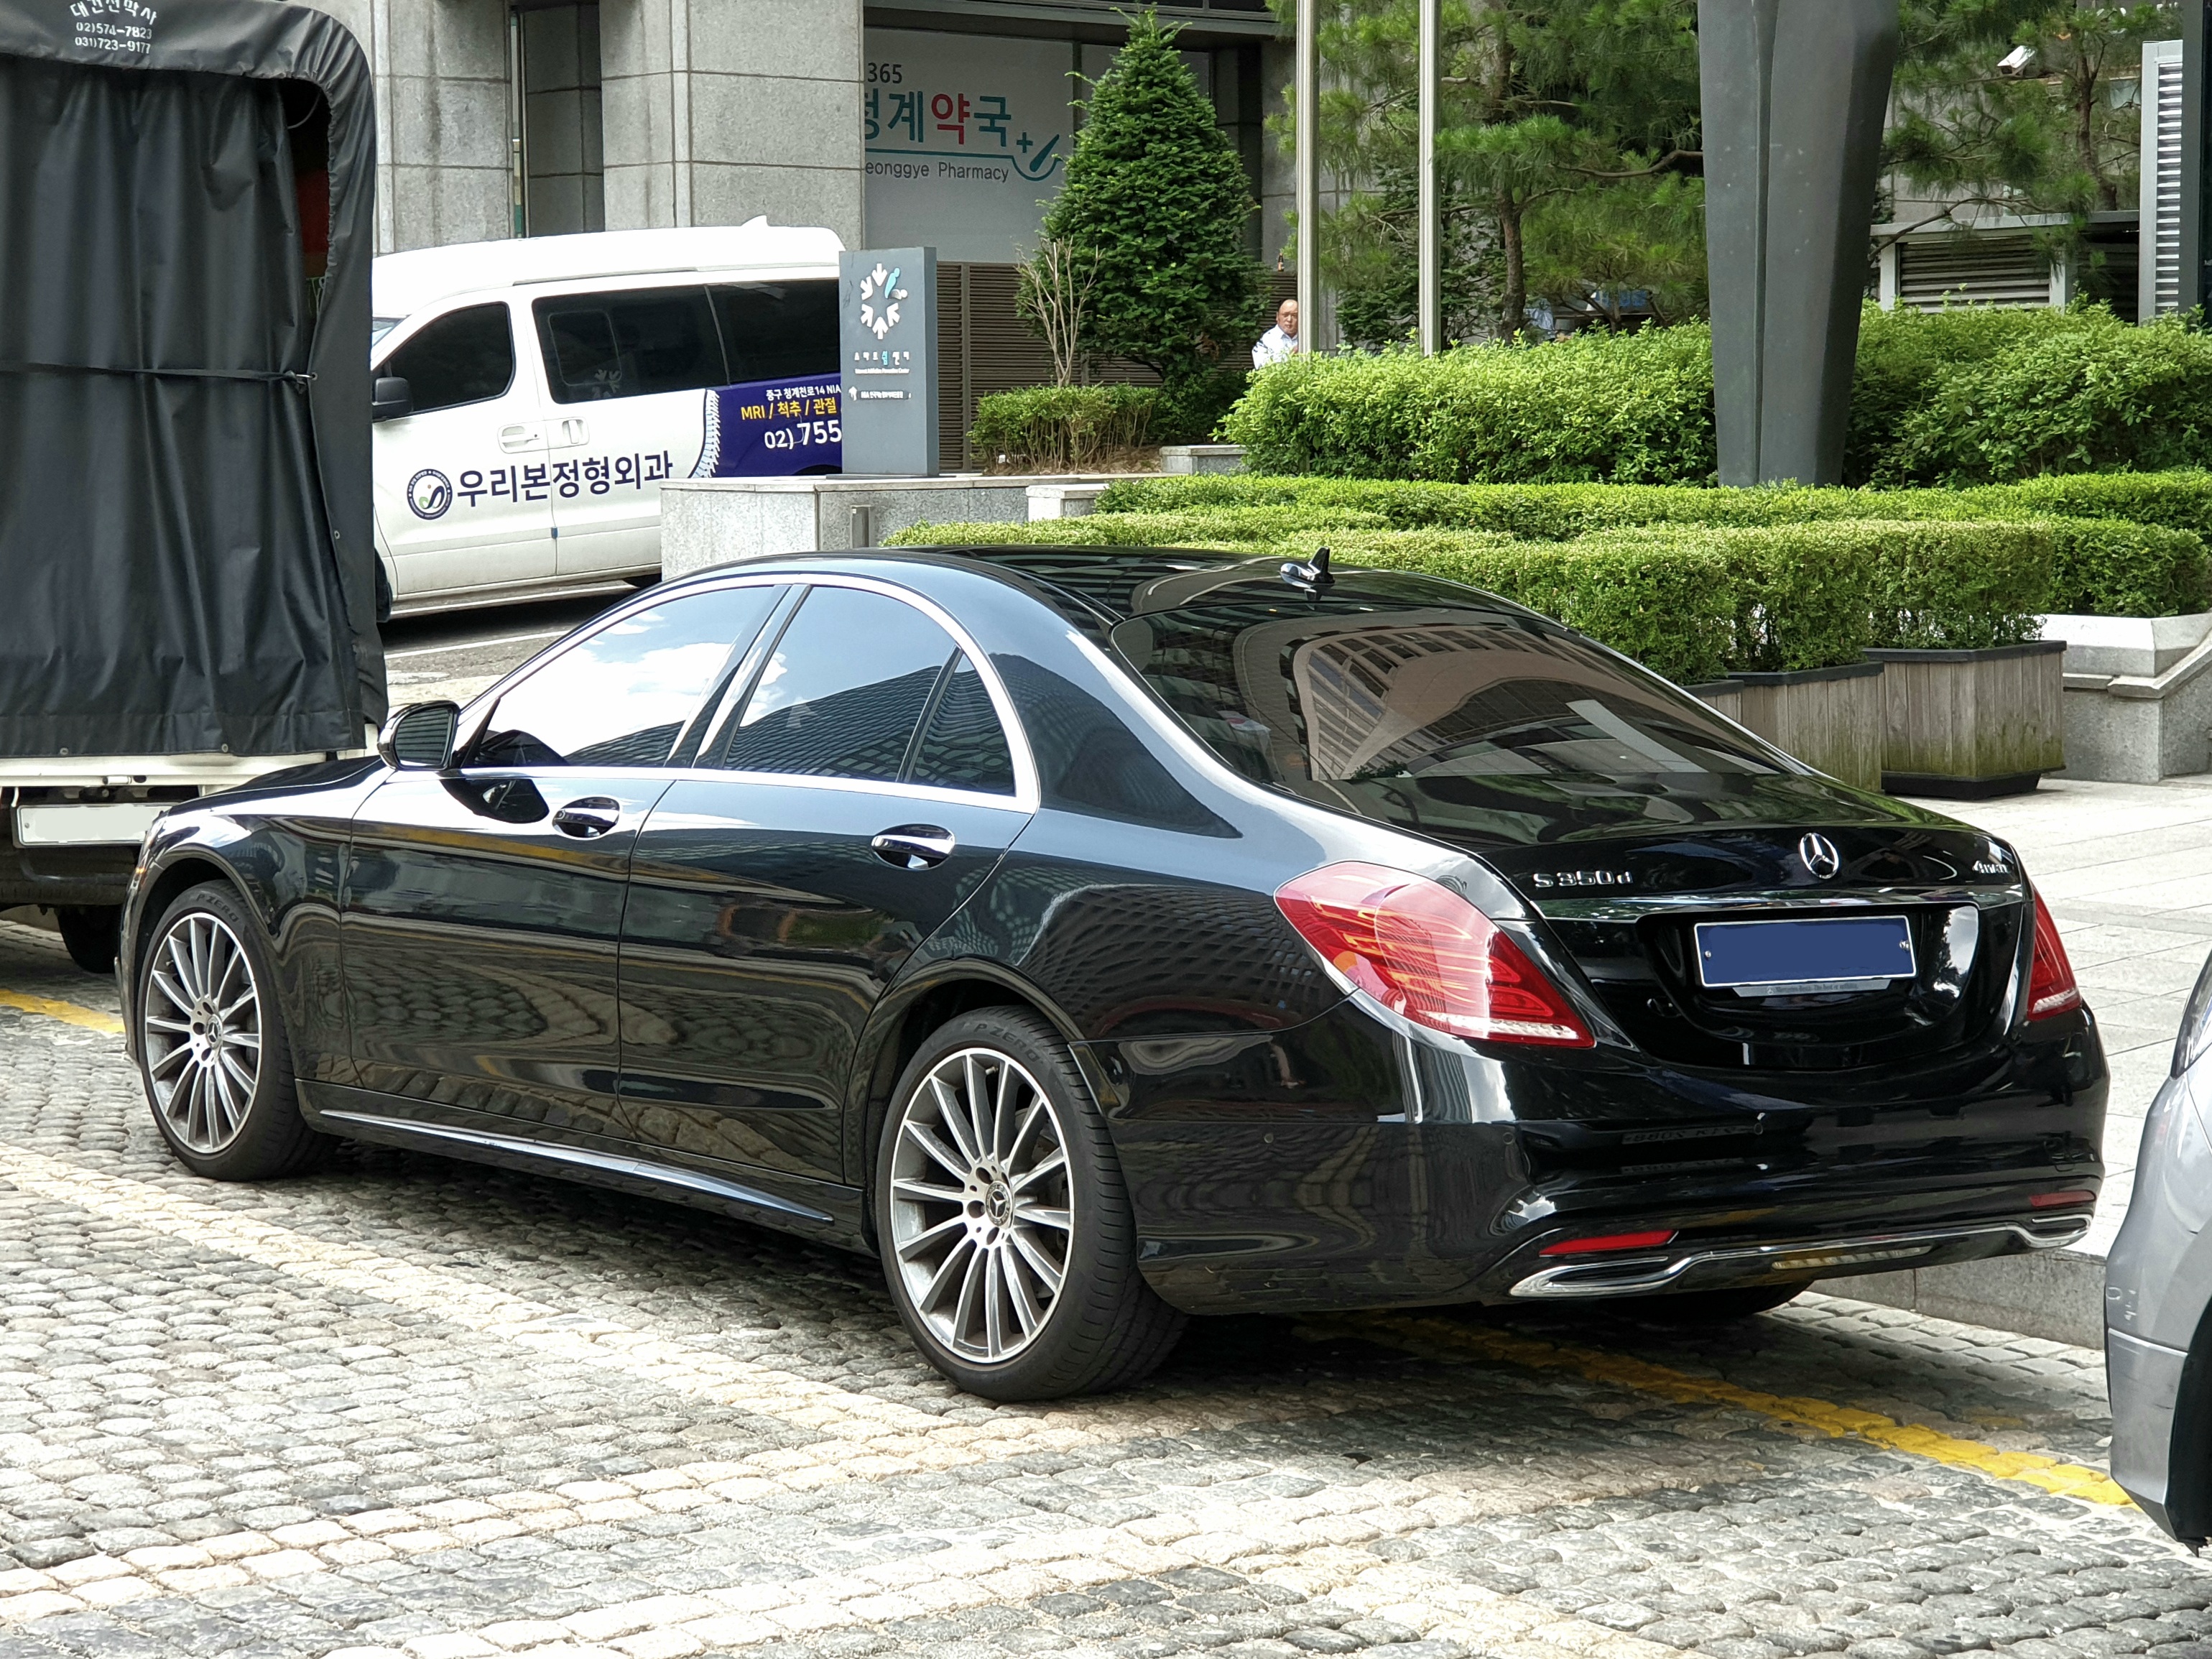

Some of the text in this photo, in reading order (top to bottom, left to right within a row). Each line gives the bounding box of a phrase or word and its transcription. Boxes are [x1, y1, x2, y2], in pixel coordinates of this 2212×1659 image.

[76, 22, 152, 39] 02)574-7823
[75, 37, 151, 54] 031)723-9177
[867, 62, 902, 83] 365
[865, 161, 1009, 182] eonggye Pharmacy
[766, 389, 782, 401] 중구
[827, 384, 841, 394] NIA
[741, 405, 765, 420] MRI
[777, 400, 802, 417] 척추
[813, 397, 837, 415] 관절
[458, 450, 673, 507] 우리본정형외과
[196, 893, 239, 923] P ZERO
[973, 1023, 987, 1032] P
